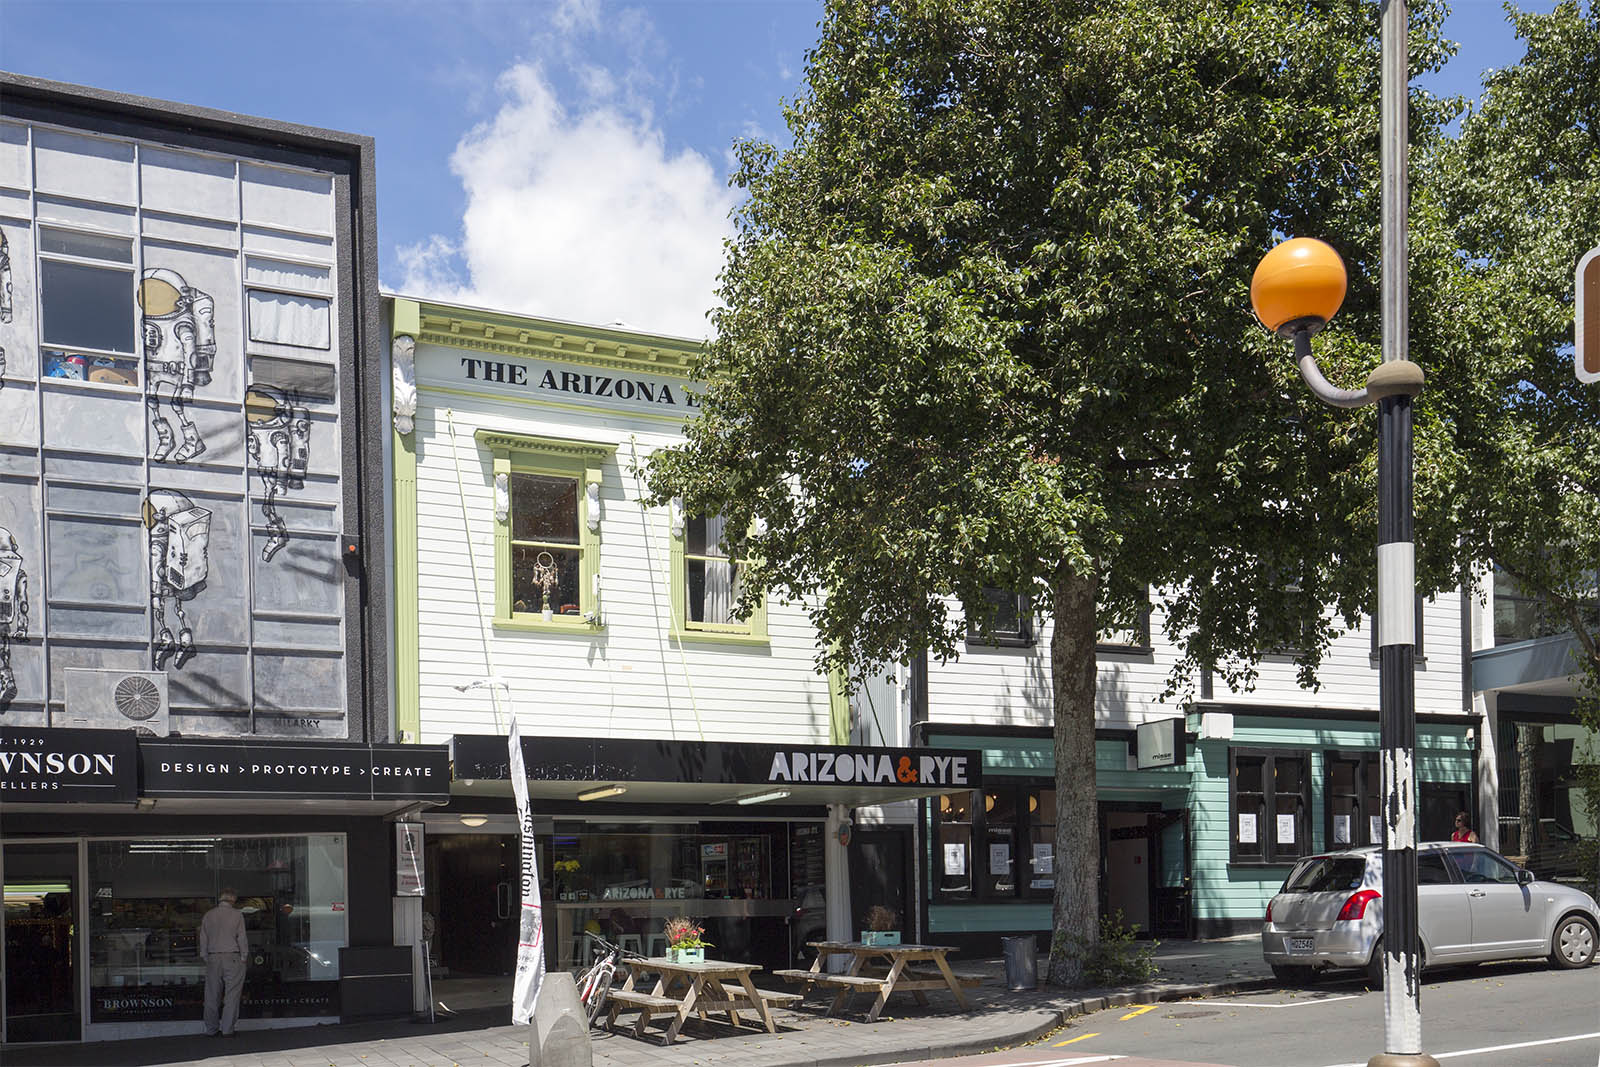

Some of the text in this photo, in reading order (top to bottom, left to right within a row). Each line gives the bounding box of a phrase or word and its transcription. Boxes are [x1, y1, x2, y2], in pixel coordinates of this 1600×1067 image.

[461, 357, 528, 386] THE
[538, 368, 677, 406] ARIZONA
[14, 738, 45, 746] 1929
[161, 763, 433, 777] DESIGN PROTOTYPE CREATE
[768, 751, 968, 785] ARIZONA & RYE
[602, 887, 655, 899] ARIZONA
[664, 887, 686, 899] RYE
[103, 999, 174, 1009] BROWNSON
